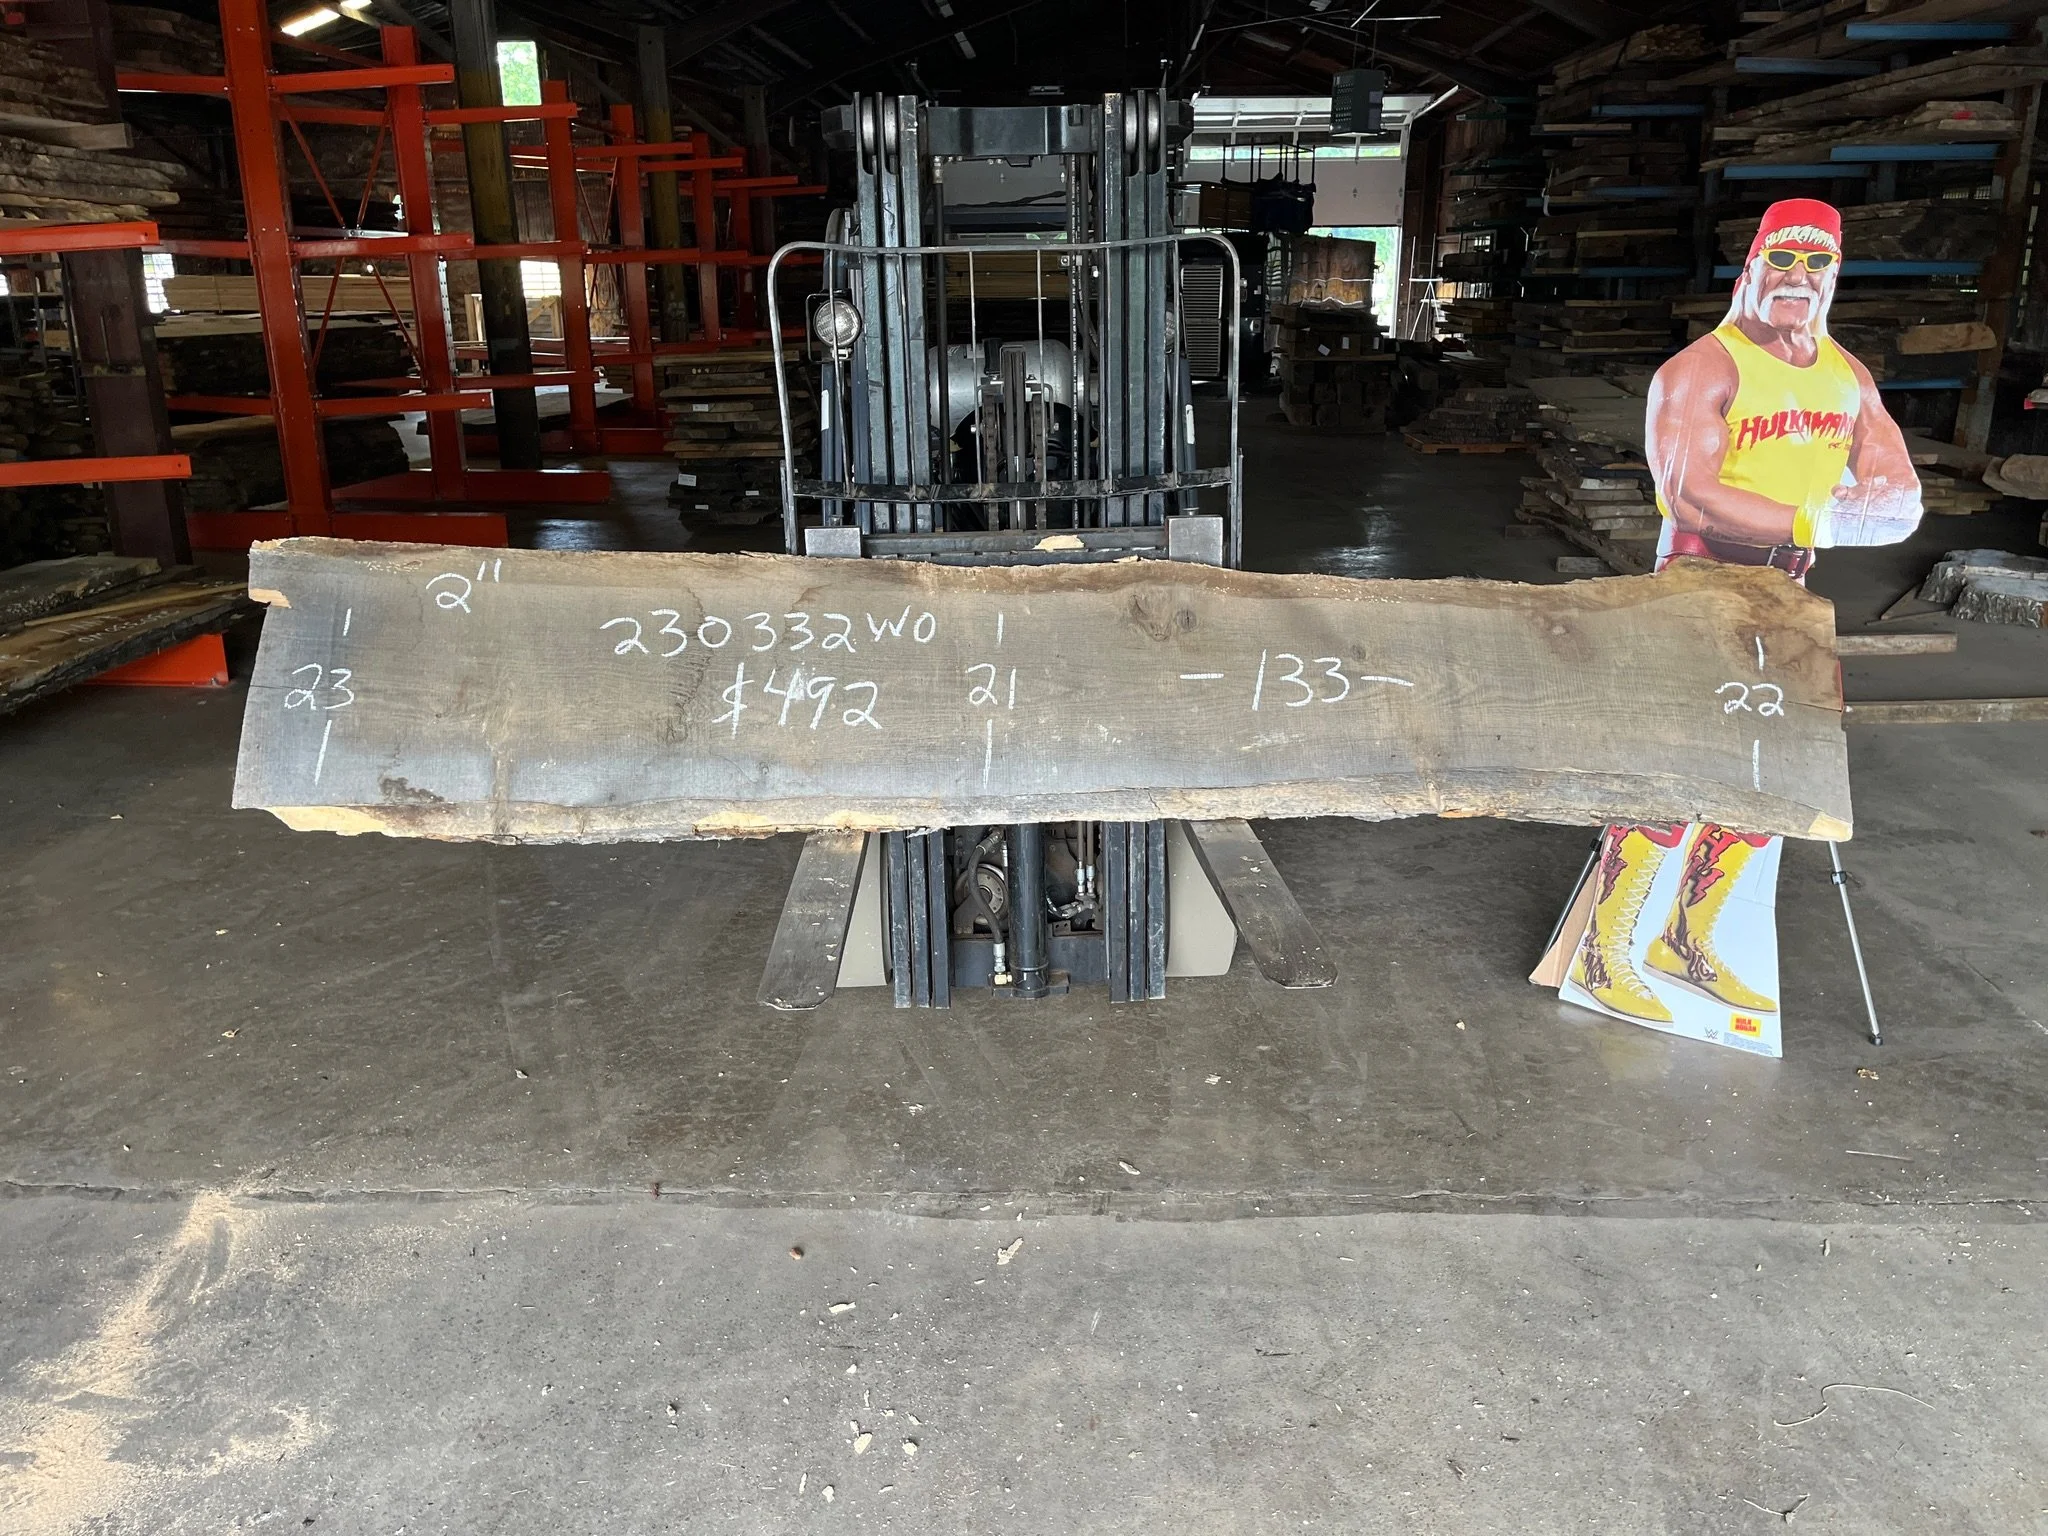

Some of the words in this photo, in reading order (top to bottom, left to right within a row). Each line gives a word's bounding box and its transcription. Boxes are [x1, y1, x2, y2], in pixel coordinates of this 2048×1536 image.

[284, 662, 356, 710] 23
[711, 661, 883, 740] $492
[966, 663, 1017, 710] 21
[1714, 681, 1785, 717] 22
